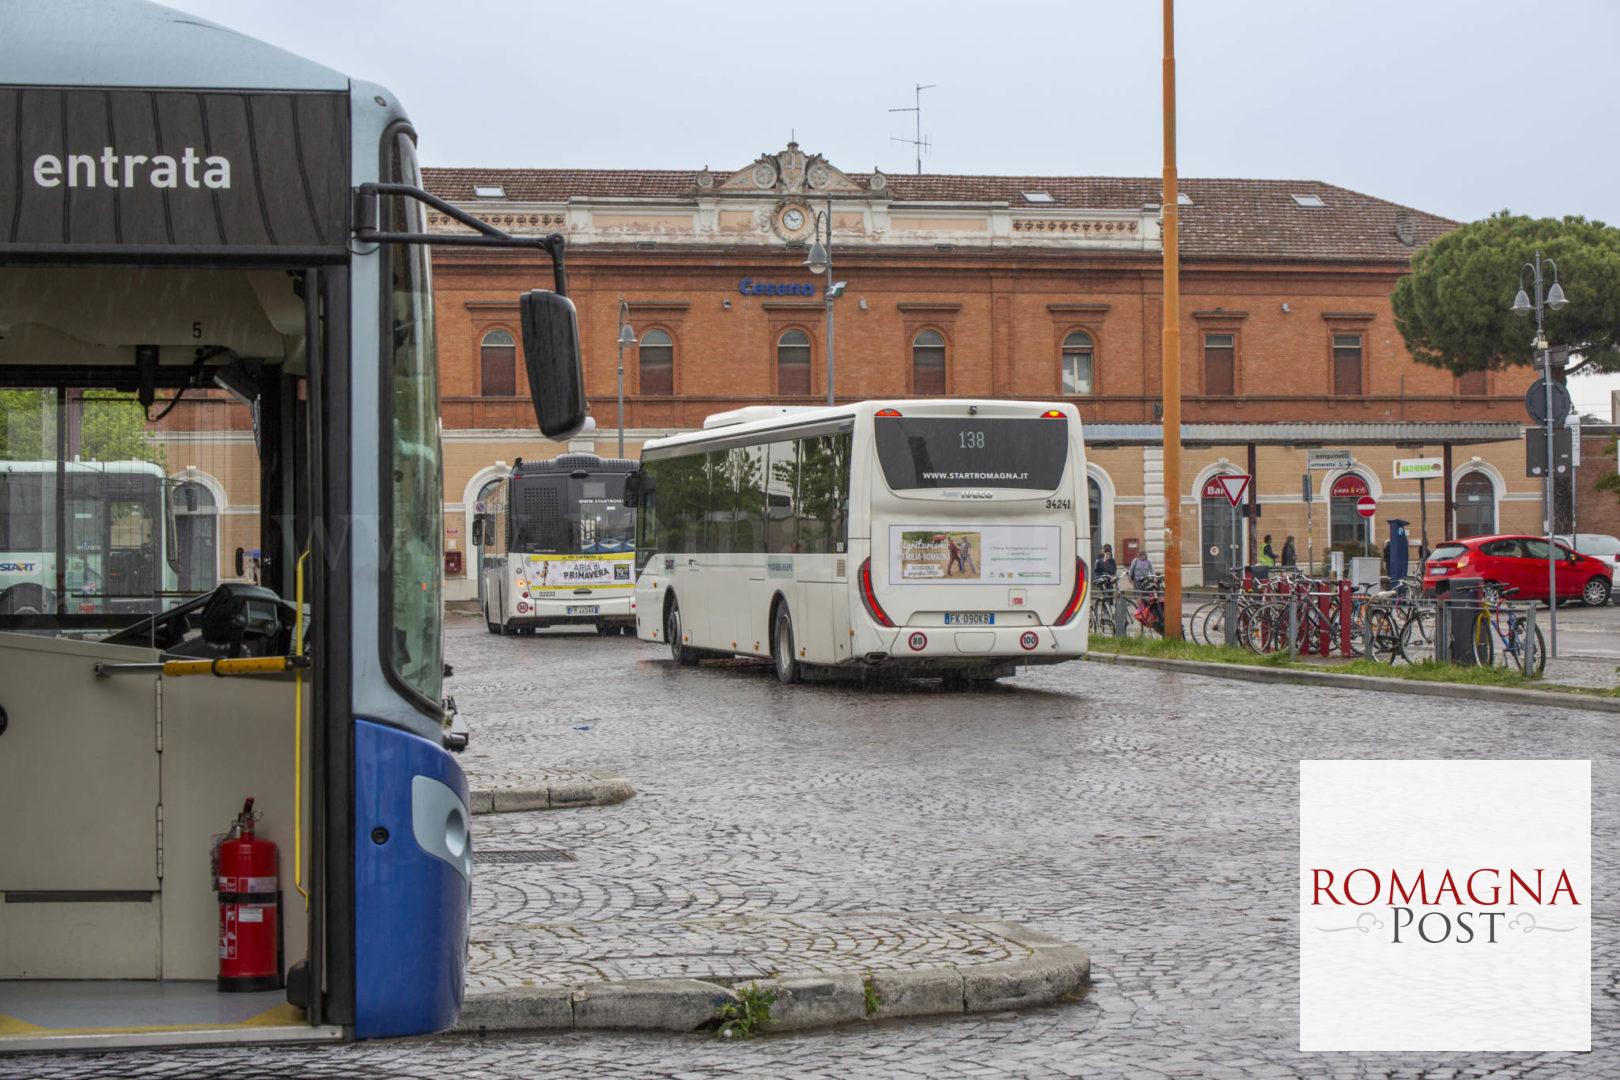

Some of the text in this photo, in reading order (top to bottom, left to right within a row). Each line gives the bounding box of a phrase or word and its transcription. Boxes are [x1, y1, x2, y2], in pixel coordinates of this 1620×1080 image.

[33, 146, 231, 189] entrata
[192, 322, 202, 338] 5
[959, 431, 985, 449] 138
[923, 472, 1029, 480] WWW.STARTROMAGNA.IT
[1046, 500, 1071, 510] 34241
[563, 568, 610, 580] PRIMAVERA
[912, 637, 923, 646] 80
[1023, 636, 1036, 646] 100
